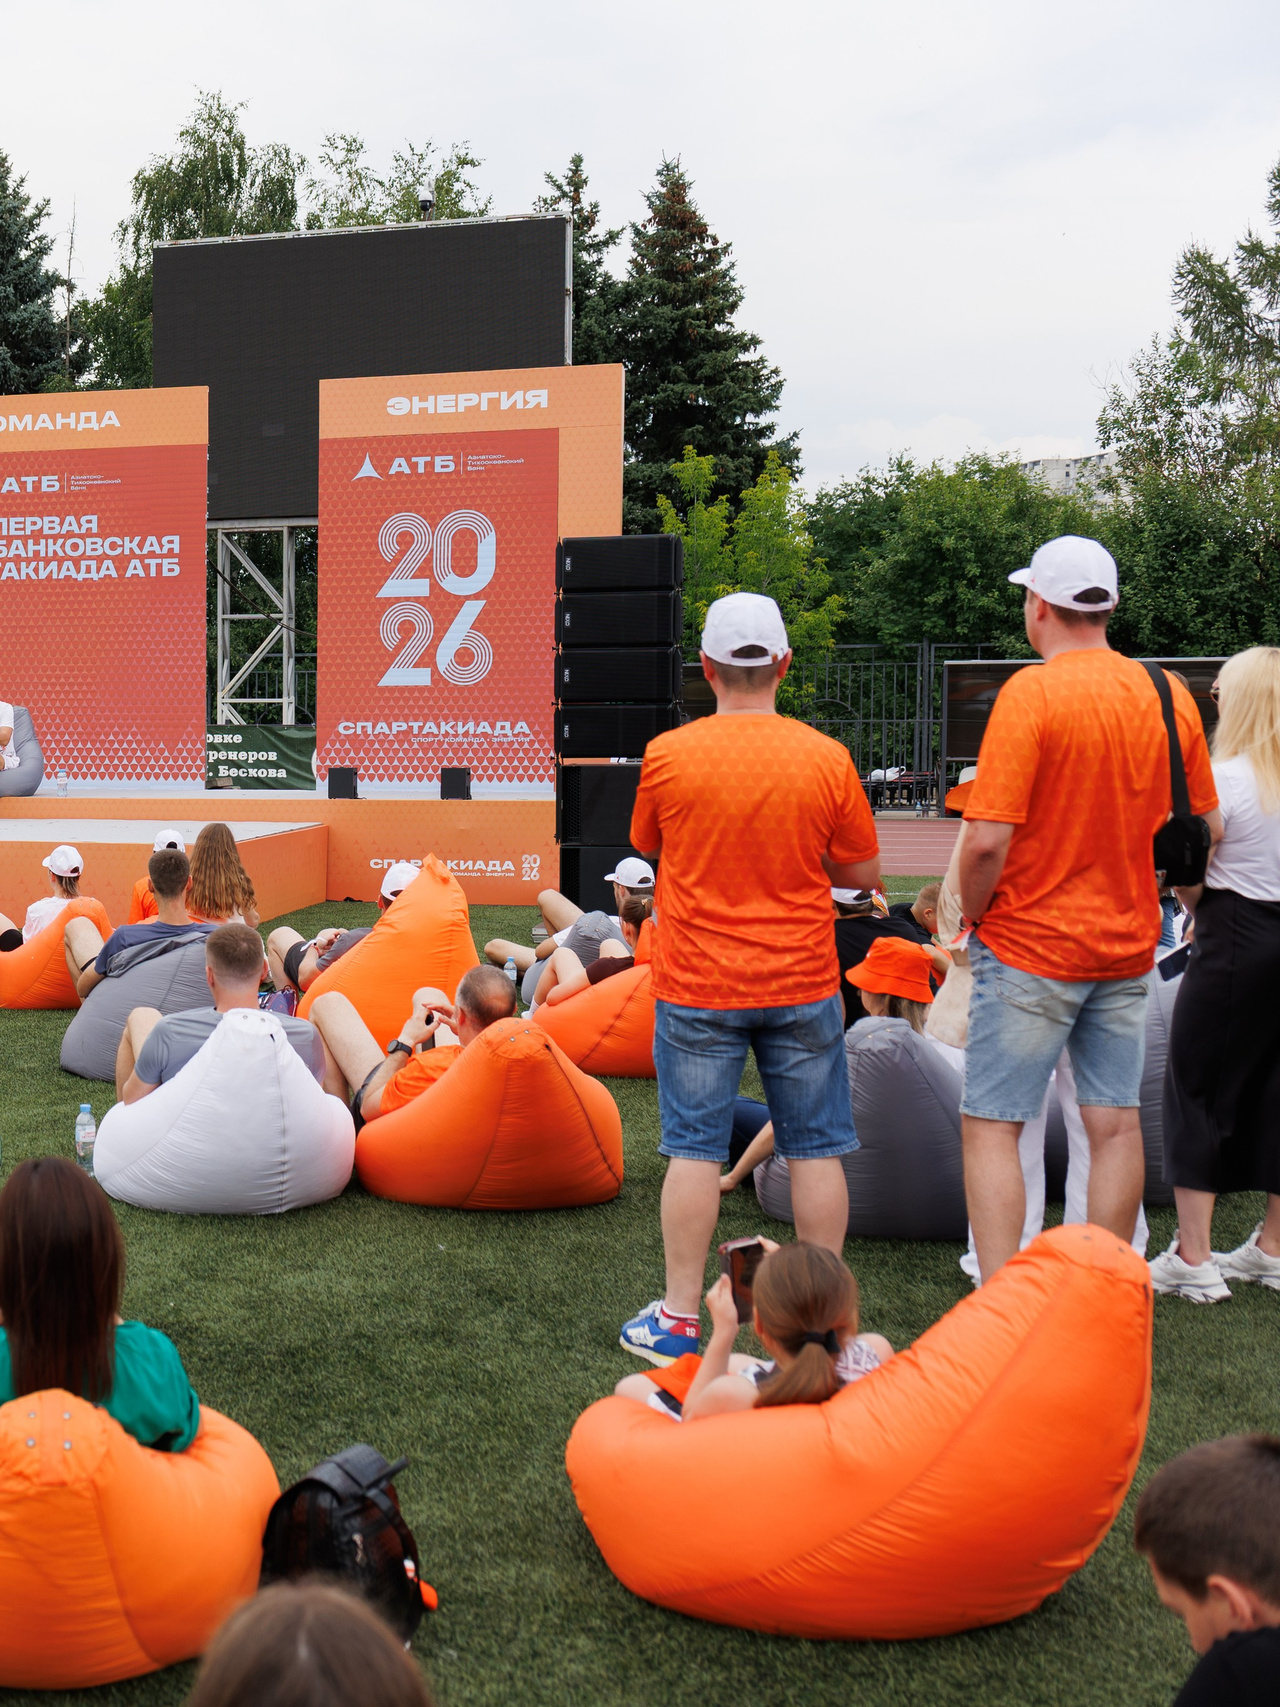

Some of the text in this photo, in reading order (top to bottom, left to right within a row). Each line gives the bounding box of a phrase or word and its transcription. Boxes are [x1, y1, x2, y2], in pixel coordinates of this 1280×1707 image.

[386, 389, 549, 416] ЭНЕРГИЯ
[388, 455, 455, 475] АТБ
[0, 475, 60, 494] АТБ
[375, 509, 496, 598] 20
[125, 557, 180, 579] АТБ
[376, 600, 493, 687] 26
[338, 721, 531, 736] СПАРТАКИАДА
[207, 750, 278, 763] ренеров
[218, 765, 287, 778] Бескова
[369, 858, 515, 872] СПРКИАДА
[521, 854, 540, 868] 20
[521, 867, 540, 881] 26
